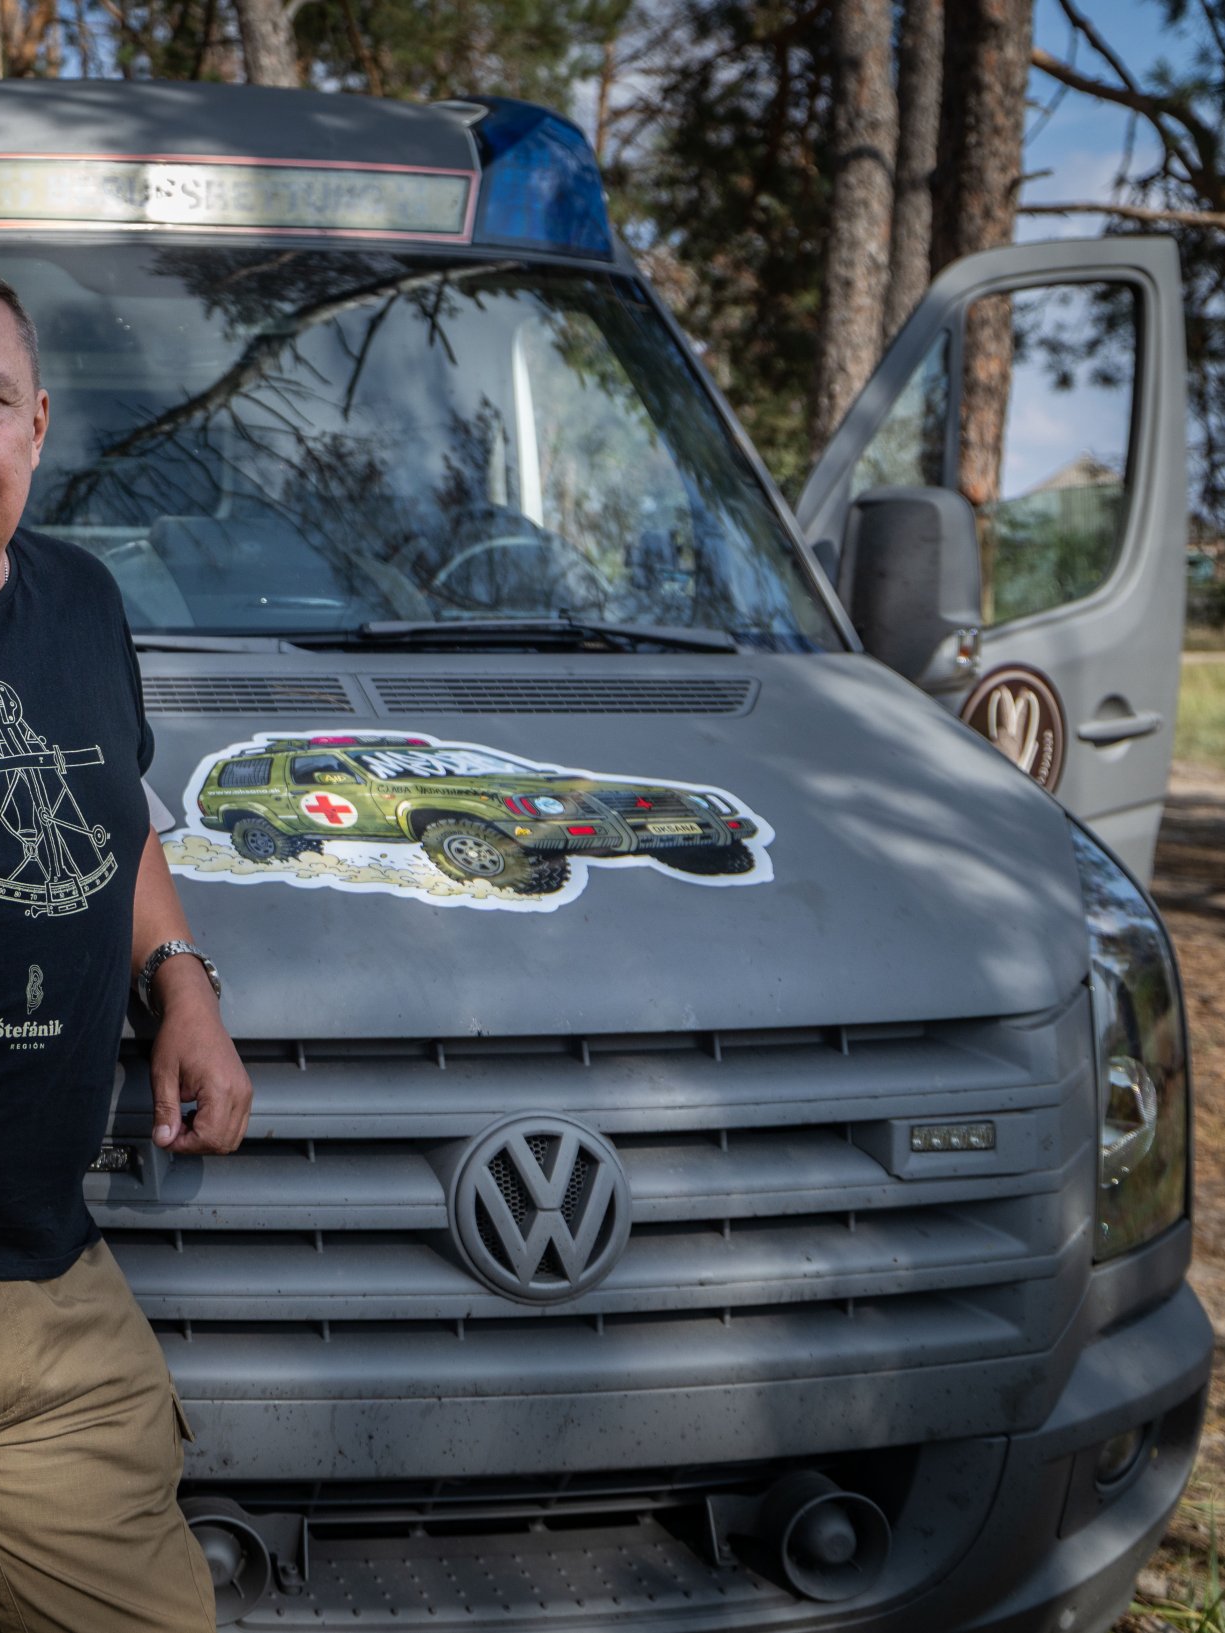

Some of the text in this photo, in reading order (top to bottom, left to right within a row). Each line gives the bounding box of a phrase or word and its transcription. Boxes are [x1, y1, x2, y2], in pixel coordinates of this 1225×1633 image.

[652, 824, 698, 833] OKSANA
[29, 893, 38, 901] 70
[10, 1042, 45, 1050] REGIÓN
[472, 1125, 619, 1293] VW
